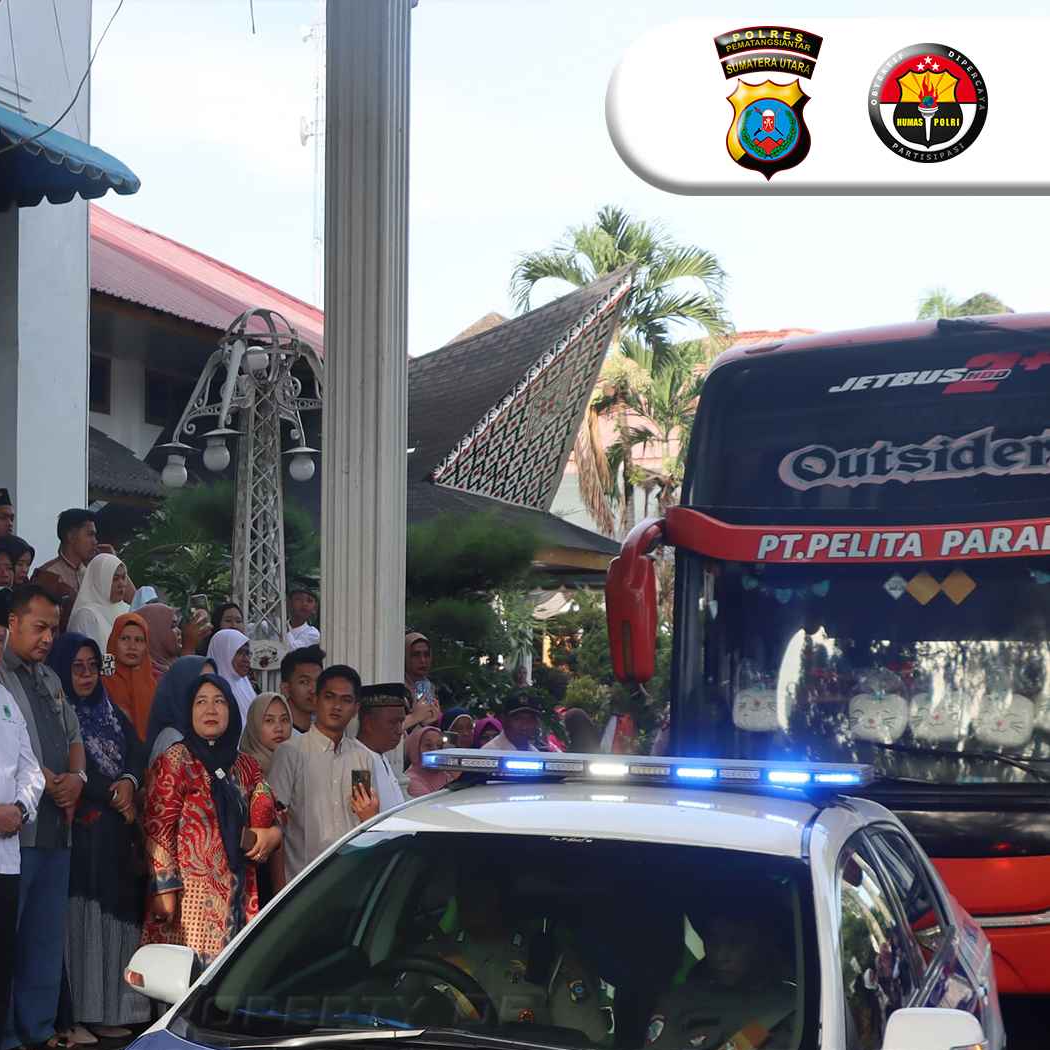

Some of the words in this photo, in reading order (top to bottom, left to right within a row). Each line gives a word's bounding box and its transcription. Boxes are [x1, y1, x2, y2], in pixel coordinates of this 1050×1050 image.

[828, 367, 968, 393] JETBUS
[756, 531, 924, 561] PT.PELITA
[938, 524, 1050, 557] PARA
